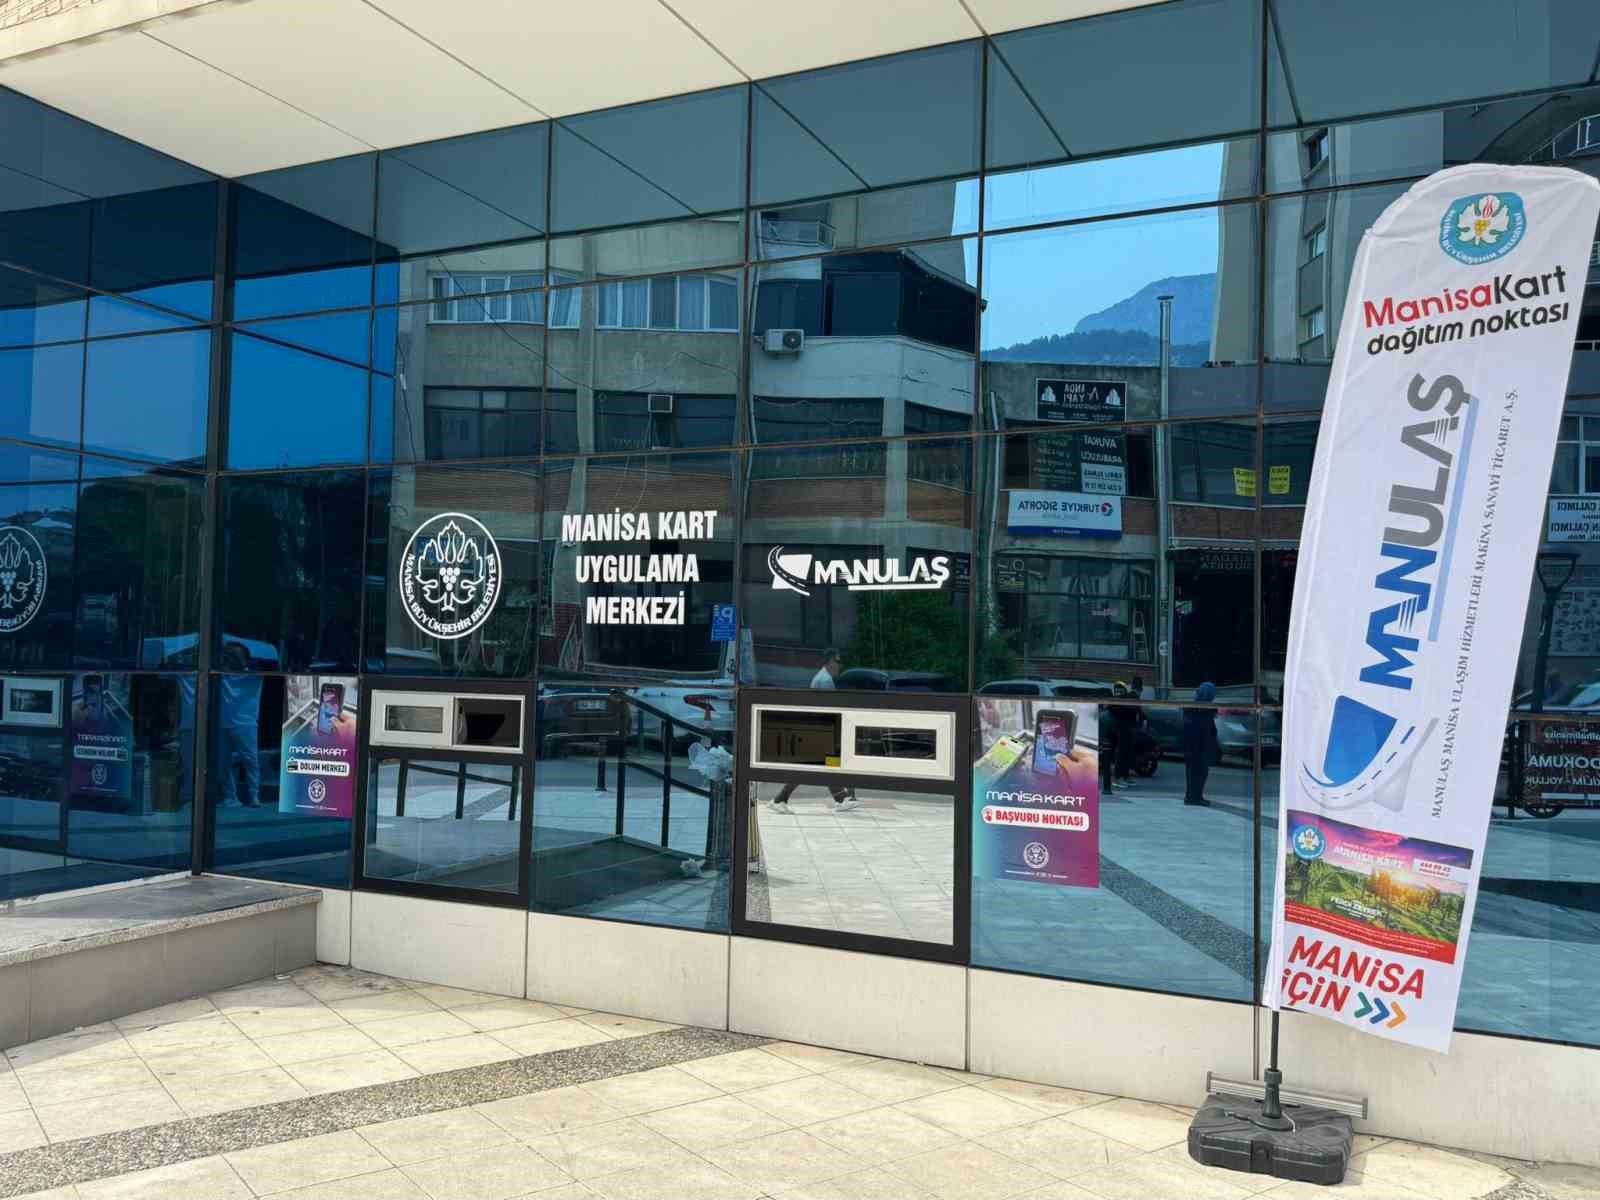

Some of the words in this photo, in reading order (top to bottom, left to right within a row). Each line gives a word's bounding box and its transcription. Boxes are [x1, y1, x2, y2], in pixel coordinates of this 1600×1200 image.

[1367, 320, 1463, 355] dağıtım
[1469, 302, 1569, 338] noktası
[1490, 415, 1511, 470] TİCARET
[1483, 473, 1501, 520] SANAYİ
[561, 507, 651, 542] MANİSA
[657, 510, 718, 540] KART
[1359, 373, 1471, 690] MANULAŞ
[1474, 522, 1493, 572] MAKİNA
[404, 552, 417, 605] MANİSA
[470, 552, 497, 623] BELEDİYESİ
[575, 553, 700, 583] UYGULAMA
[814, 556, 950, 589] MANULAŞ
[410, 599, 473, 635] BÜYÜKŞEHİR
[585, 590, 685, 625] MERKEZİ
[1460, 574, 1482, 652] HİZMETLERİ
[1451, 655, 1470, 703] ULAŞIM
[1441, 706, 1460, 755] MANİSA
[1431, 757, 1453, 819] MANULAŞ
[995, 810, 1040, 824] BAŞVURU
[1041, 813, 1084, 827] NOKTASI
